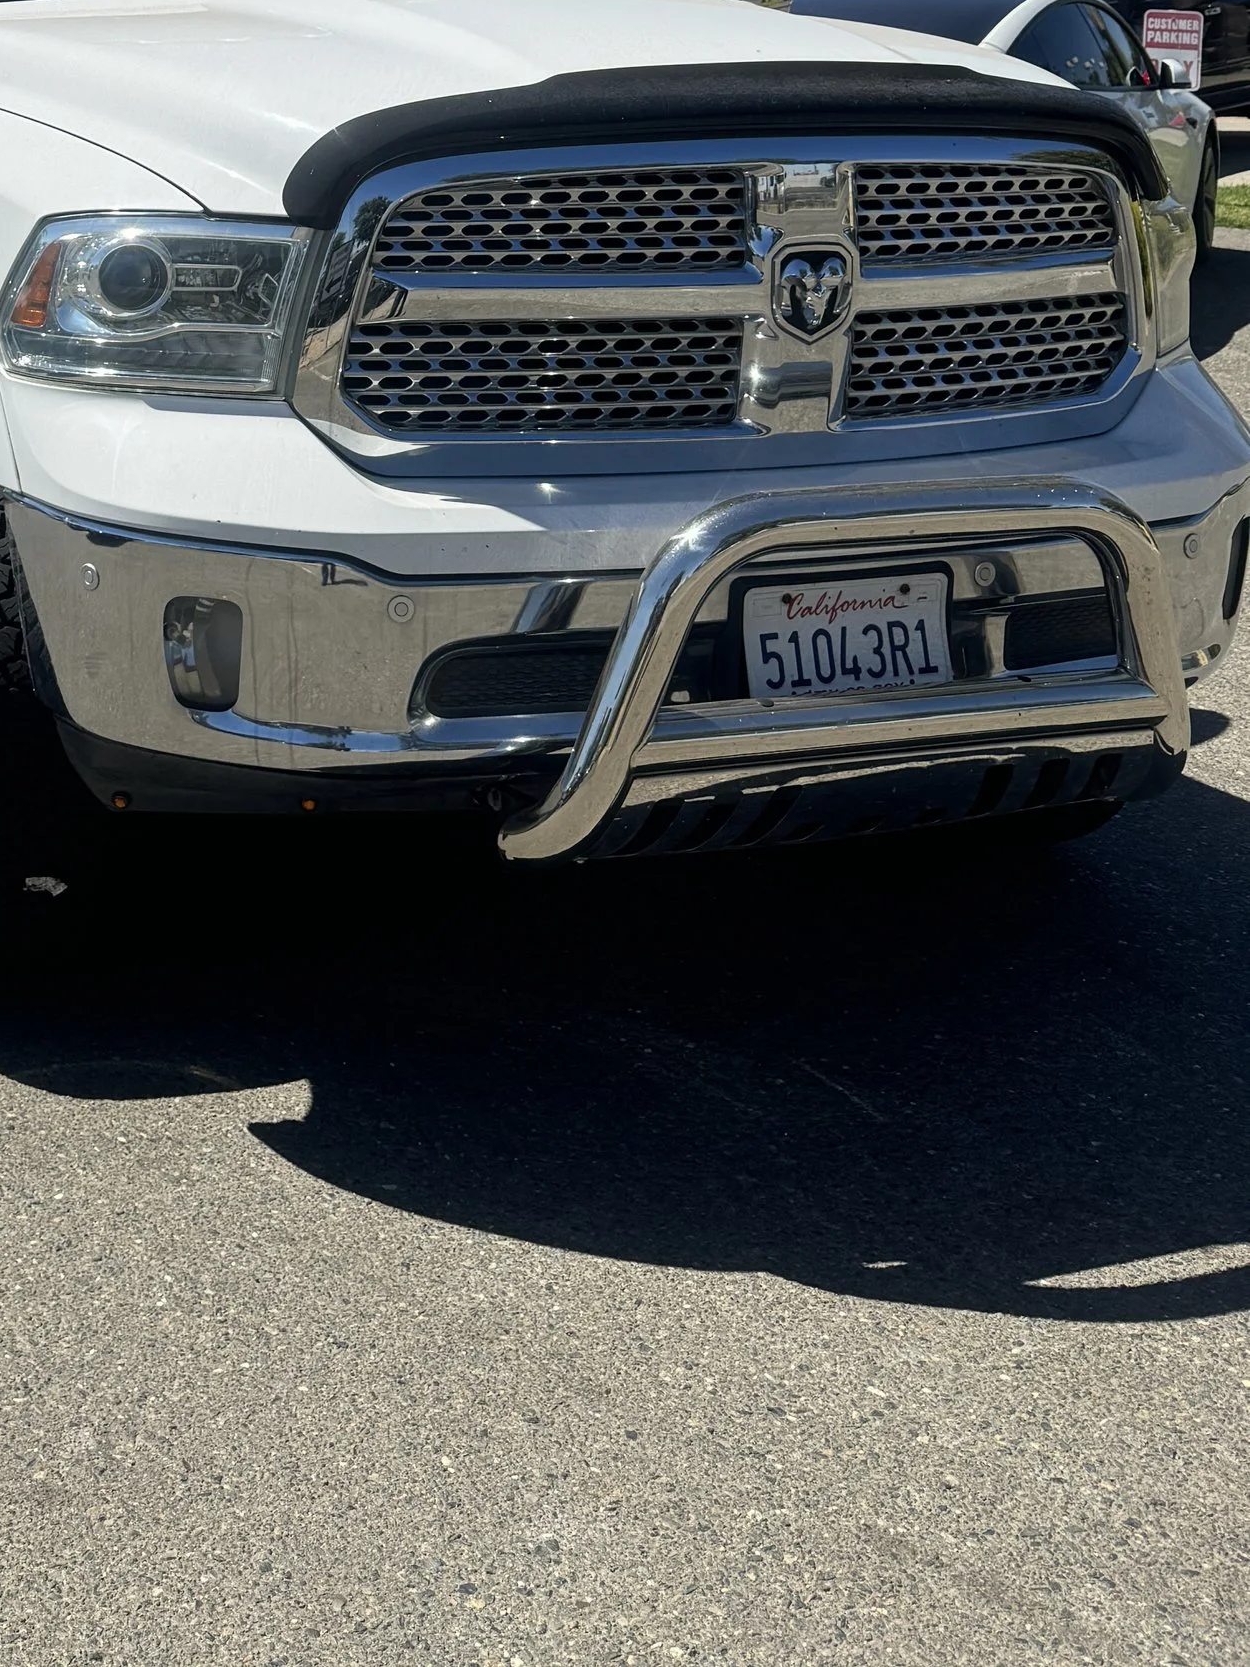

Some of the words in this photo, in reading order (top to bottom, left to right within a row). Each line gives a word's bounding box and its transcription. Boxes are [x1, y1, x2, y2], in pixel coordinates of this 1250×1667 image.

[1147, 17, 1199, 31] CUSTOMER
[1146, 30, 1198, 45] PARKING
[786, 590, 908, 625] California
[759, 619, 938, 690] 51043R1
